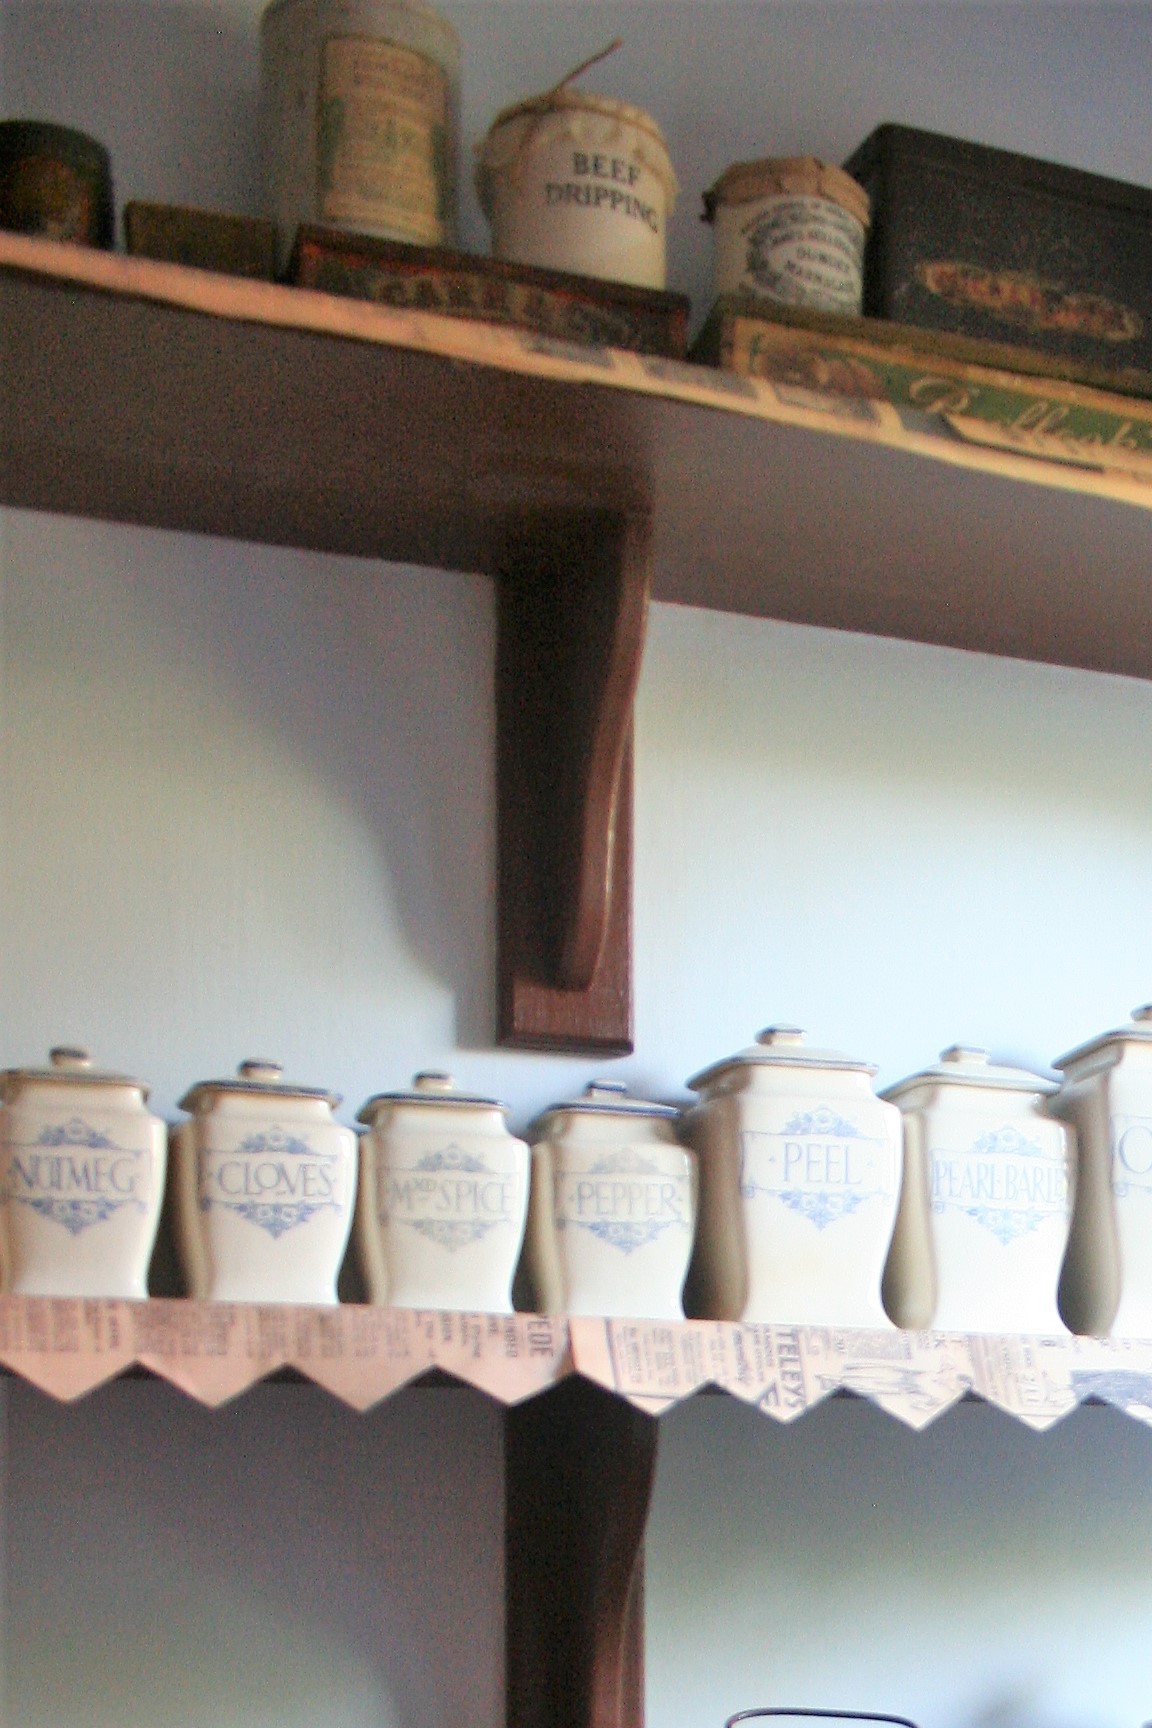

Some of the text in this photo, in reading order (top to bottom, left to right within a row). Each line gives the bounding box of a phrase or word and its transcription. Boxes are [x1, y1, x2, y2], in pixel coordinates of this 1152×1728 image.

[573, 151, 641, 187] BEEF
[545, 182, 658, 233] DRIPPING
[12, 1154, 136, 1192] NUTMEG
[218, 1160, 333, 1197] CLOVES
[782, 1140, 863, 1186] PEEL
[933, 1159, 1069, 1204] PEARL BARLE
[441, 1180, 512, 1214] SPICE
[576, 1180, 682, 1216] PEPPER
